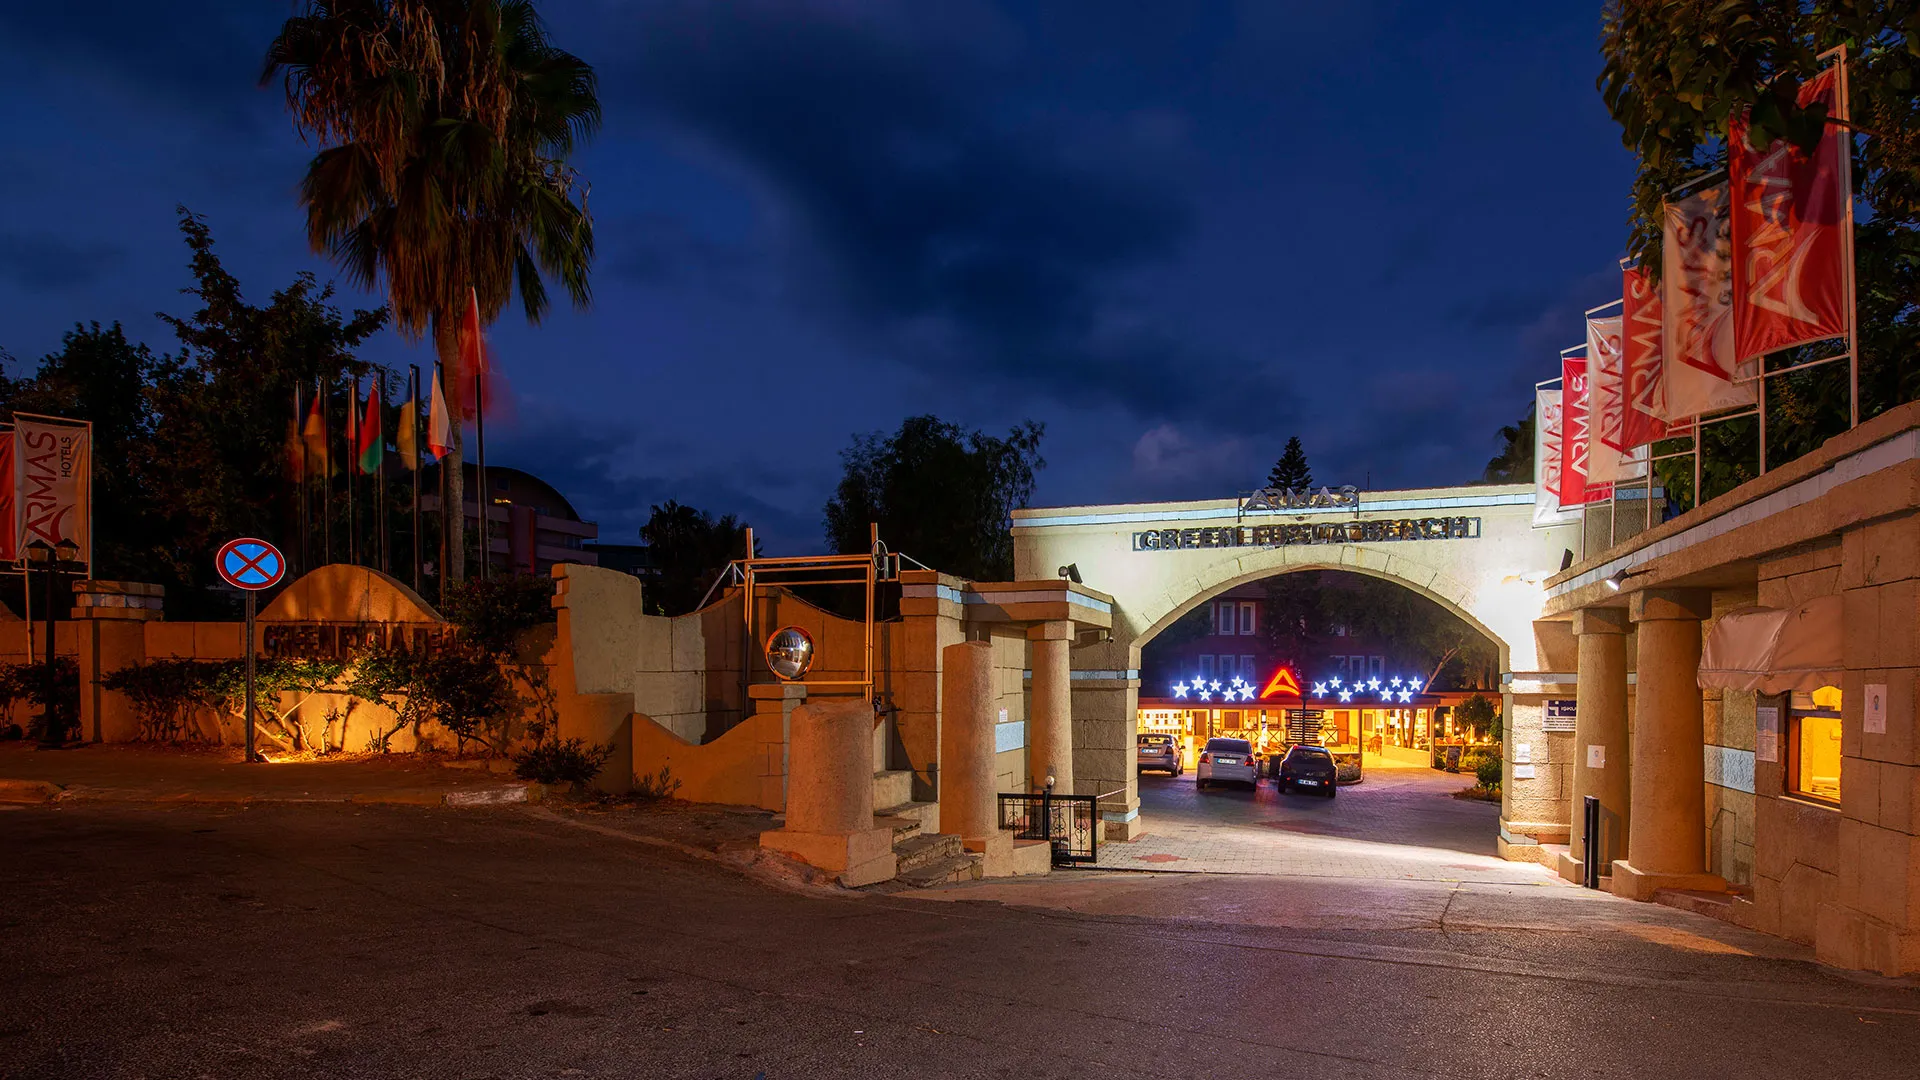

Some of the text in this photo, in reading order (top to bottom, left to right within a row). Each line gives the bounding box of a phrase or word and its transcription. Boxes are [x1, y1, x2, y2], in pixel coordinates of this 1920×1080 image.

[1571, 372, 1589, 476] ARMAS
[61, 436, 72, 478] HOTELS
[26, 431, 63, 548] ARMAS
[1243, 485, 1359, 513] ARMAS
[1139, 526, 1239, 551] GREEN
[1360, 516, 1469, 544] BEACH
